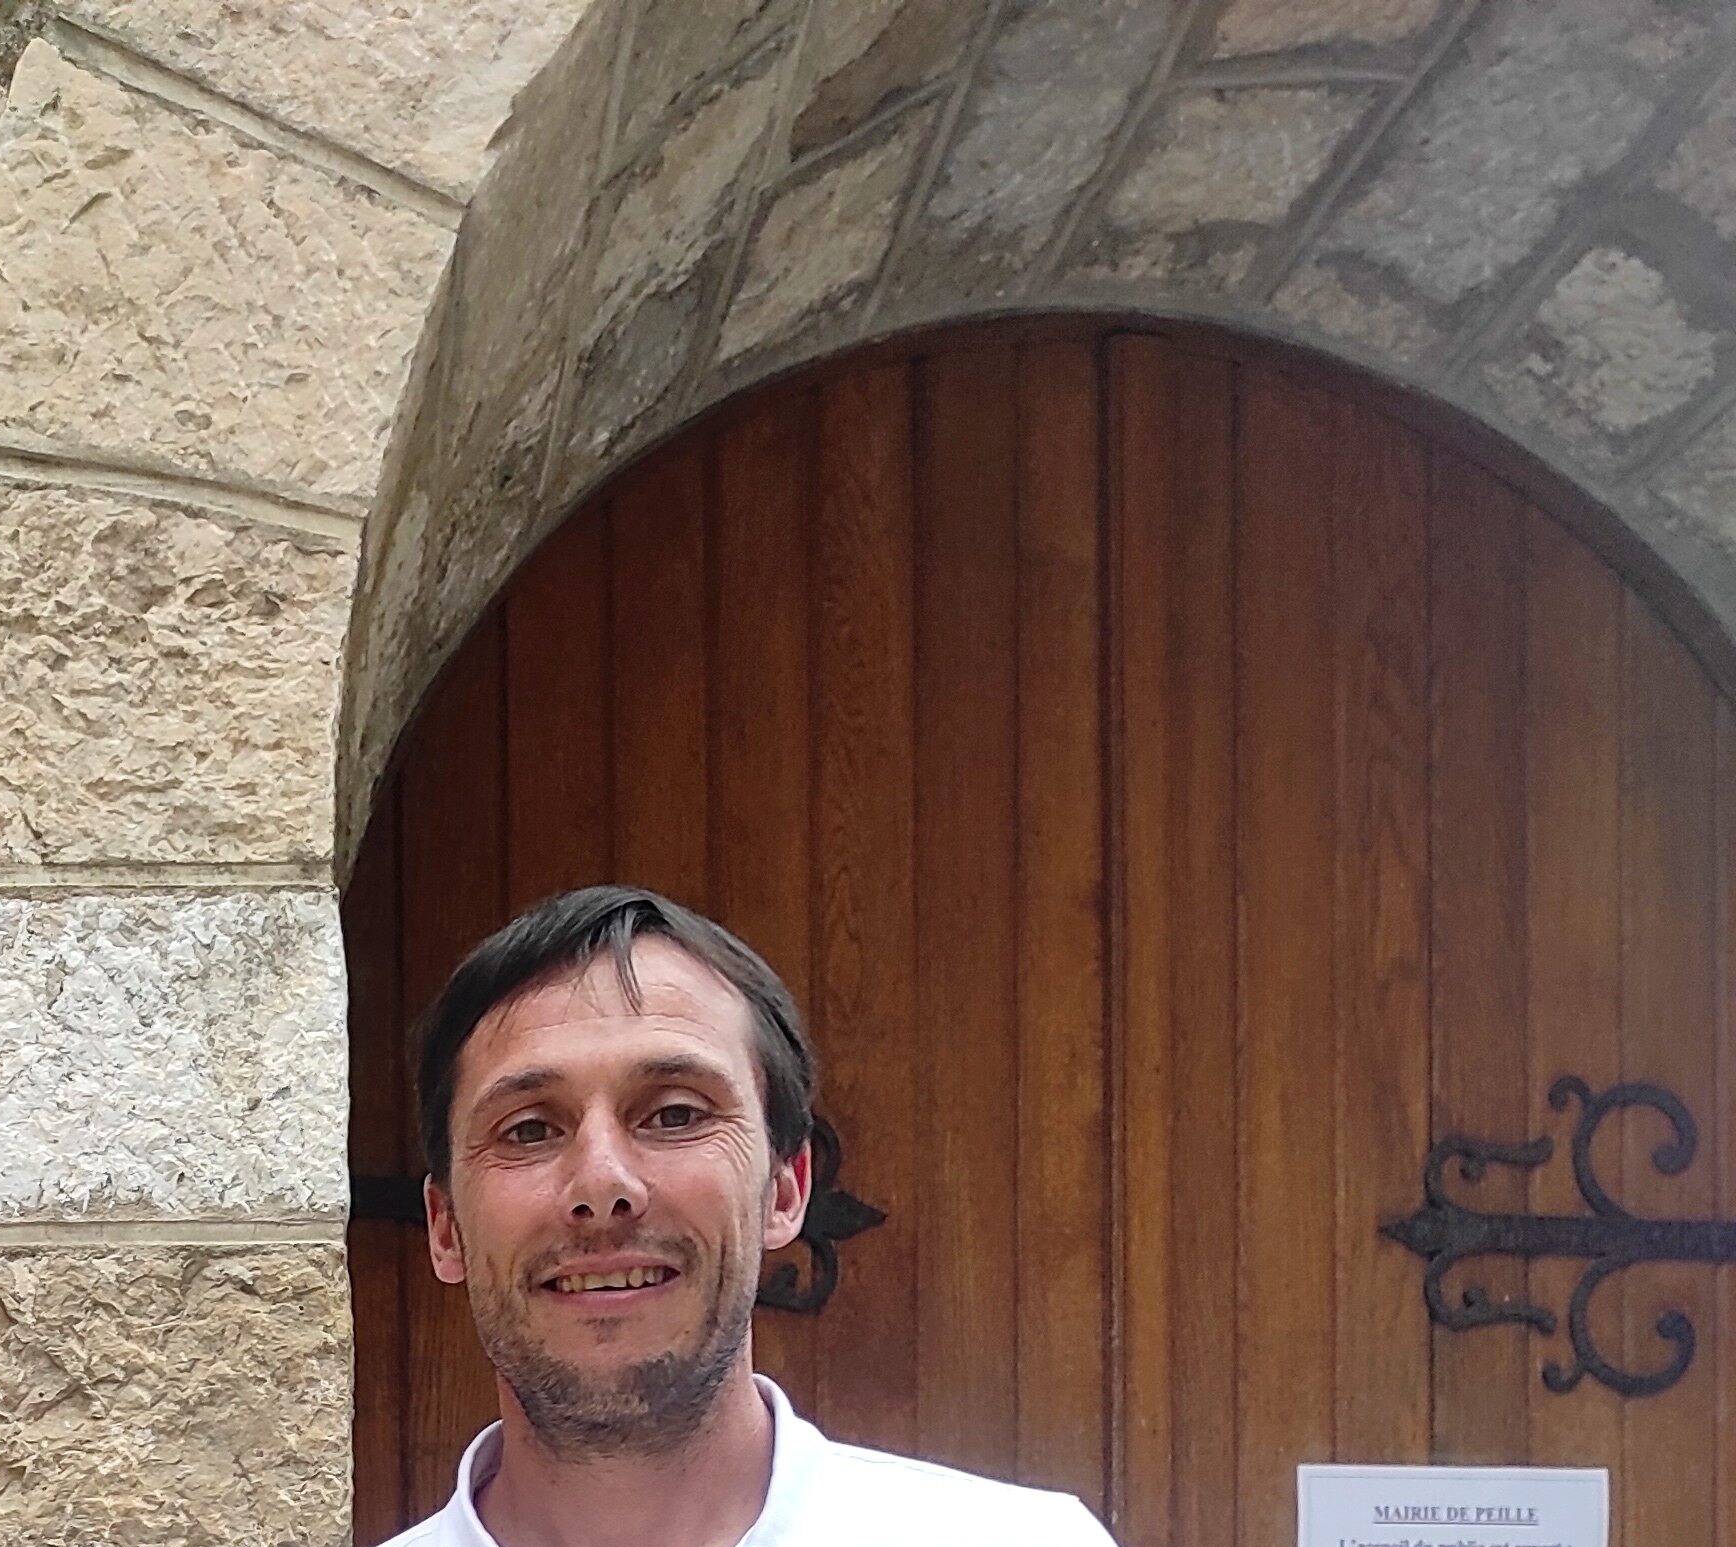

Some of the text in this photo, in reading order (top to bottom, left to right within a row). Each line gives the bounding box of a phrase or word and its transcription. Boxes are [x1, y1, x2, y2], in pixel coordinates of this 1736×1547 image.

[1373, 1505, 1538, 1522] MAIRIE DE PEILLE
